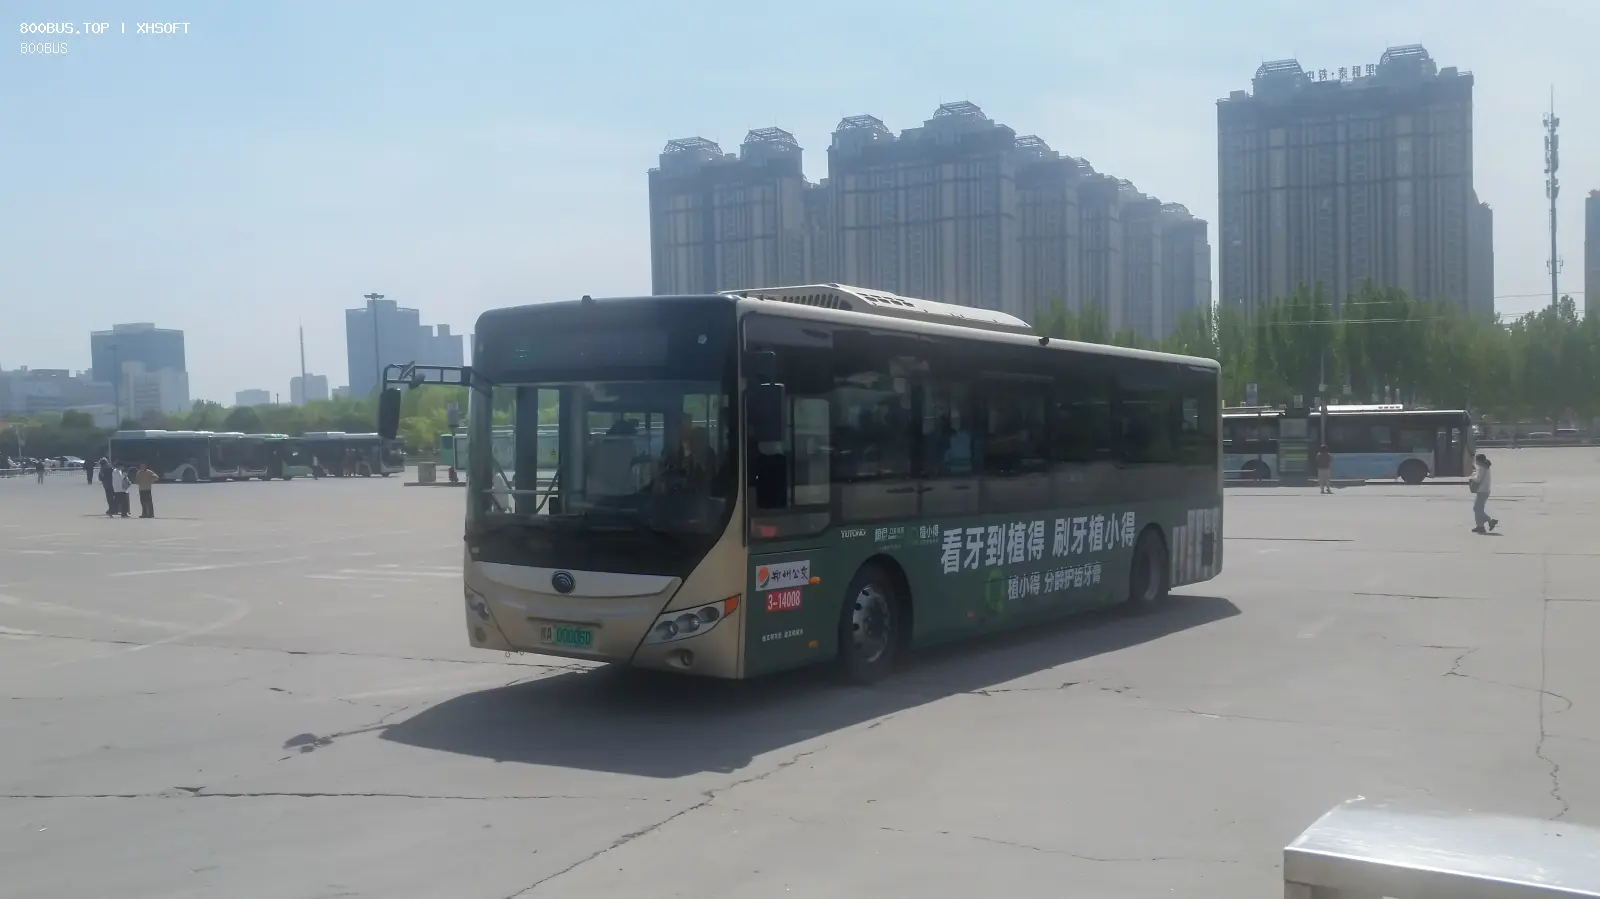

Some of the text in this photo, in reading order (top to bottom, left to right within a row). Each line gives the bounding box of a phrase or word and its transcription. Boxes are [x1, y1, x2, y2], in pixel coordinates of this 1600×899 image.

[941, 511, 1136, 574] 看牙到植得 刷牙植小得
[771, 565, 808, 582] 郑州公交
[1008, 571, 1040, 600] 植小得
[767, 590, 801, 611] 3-14008
